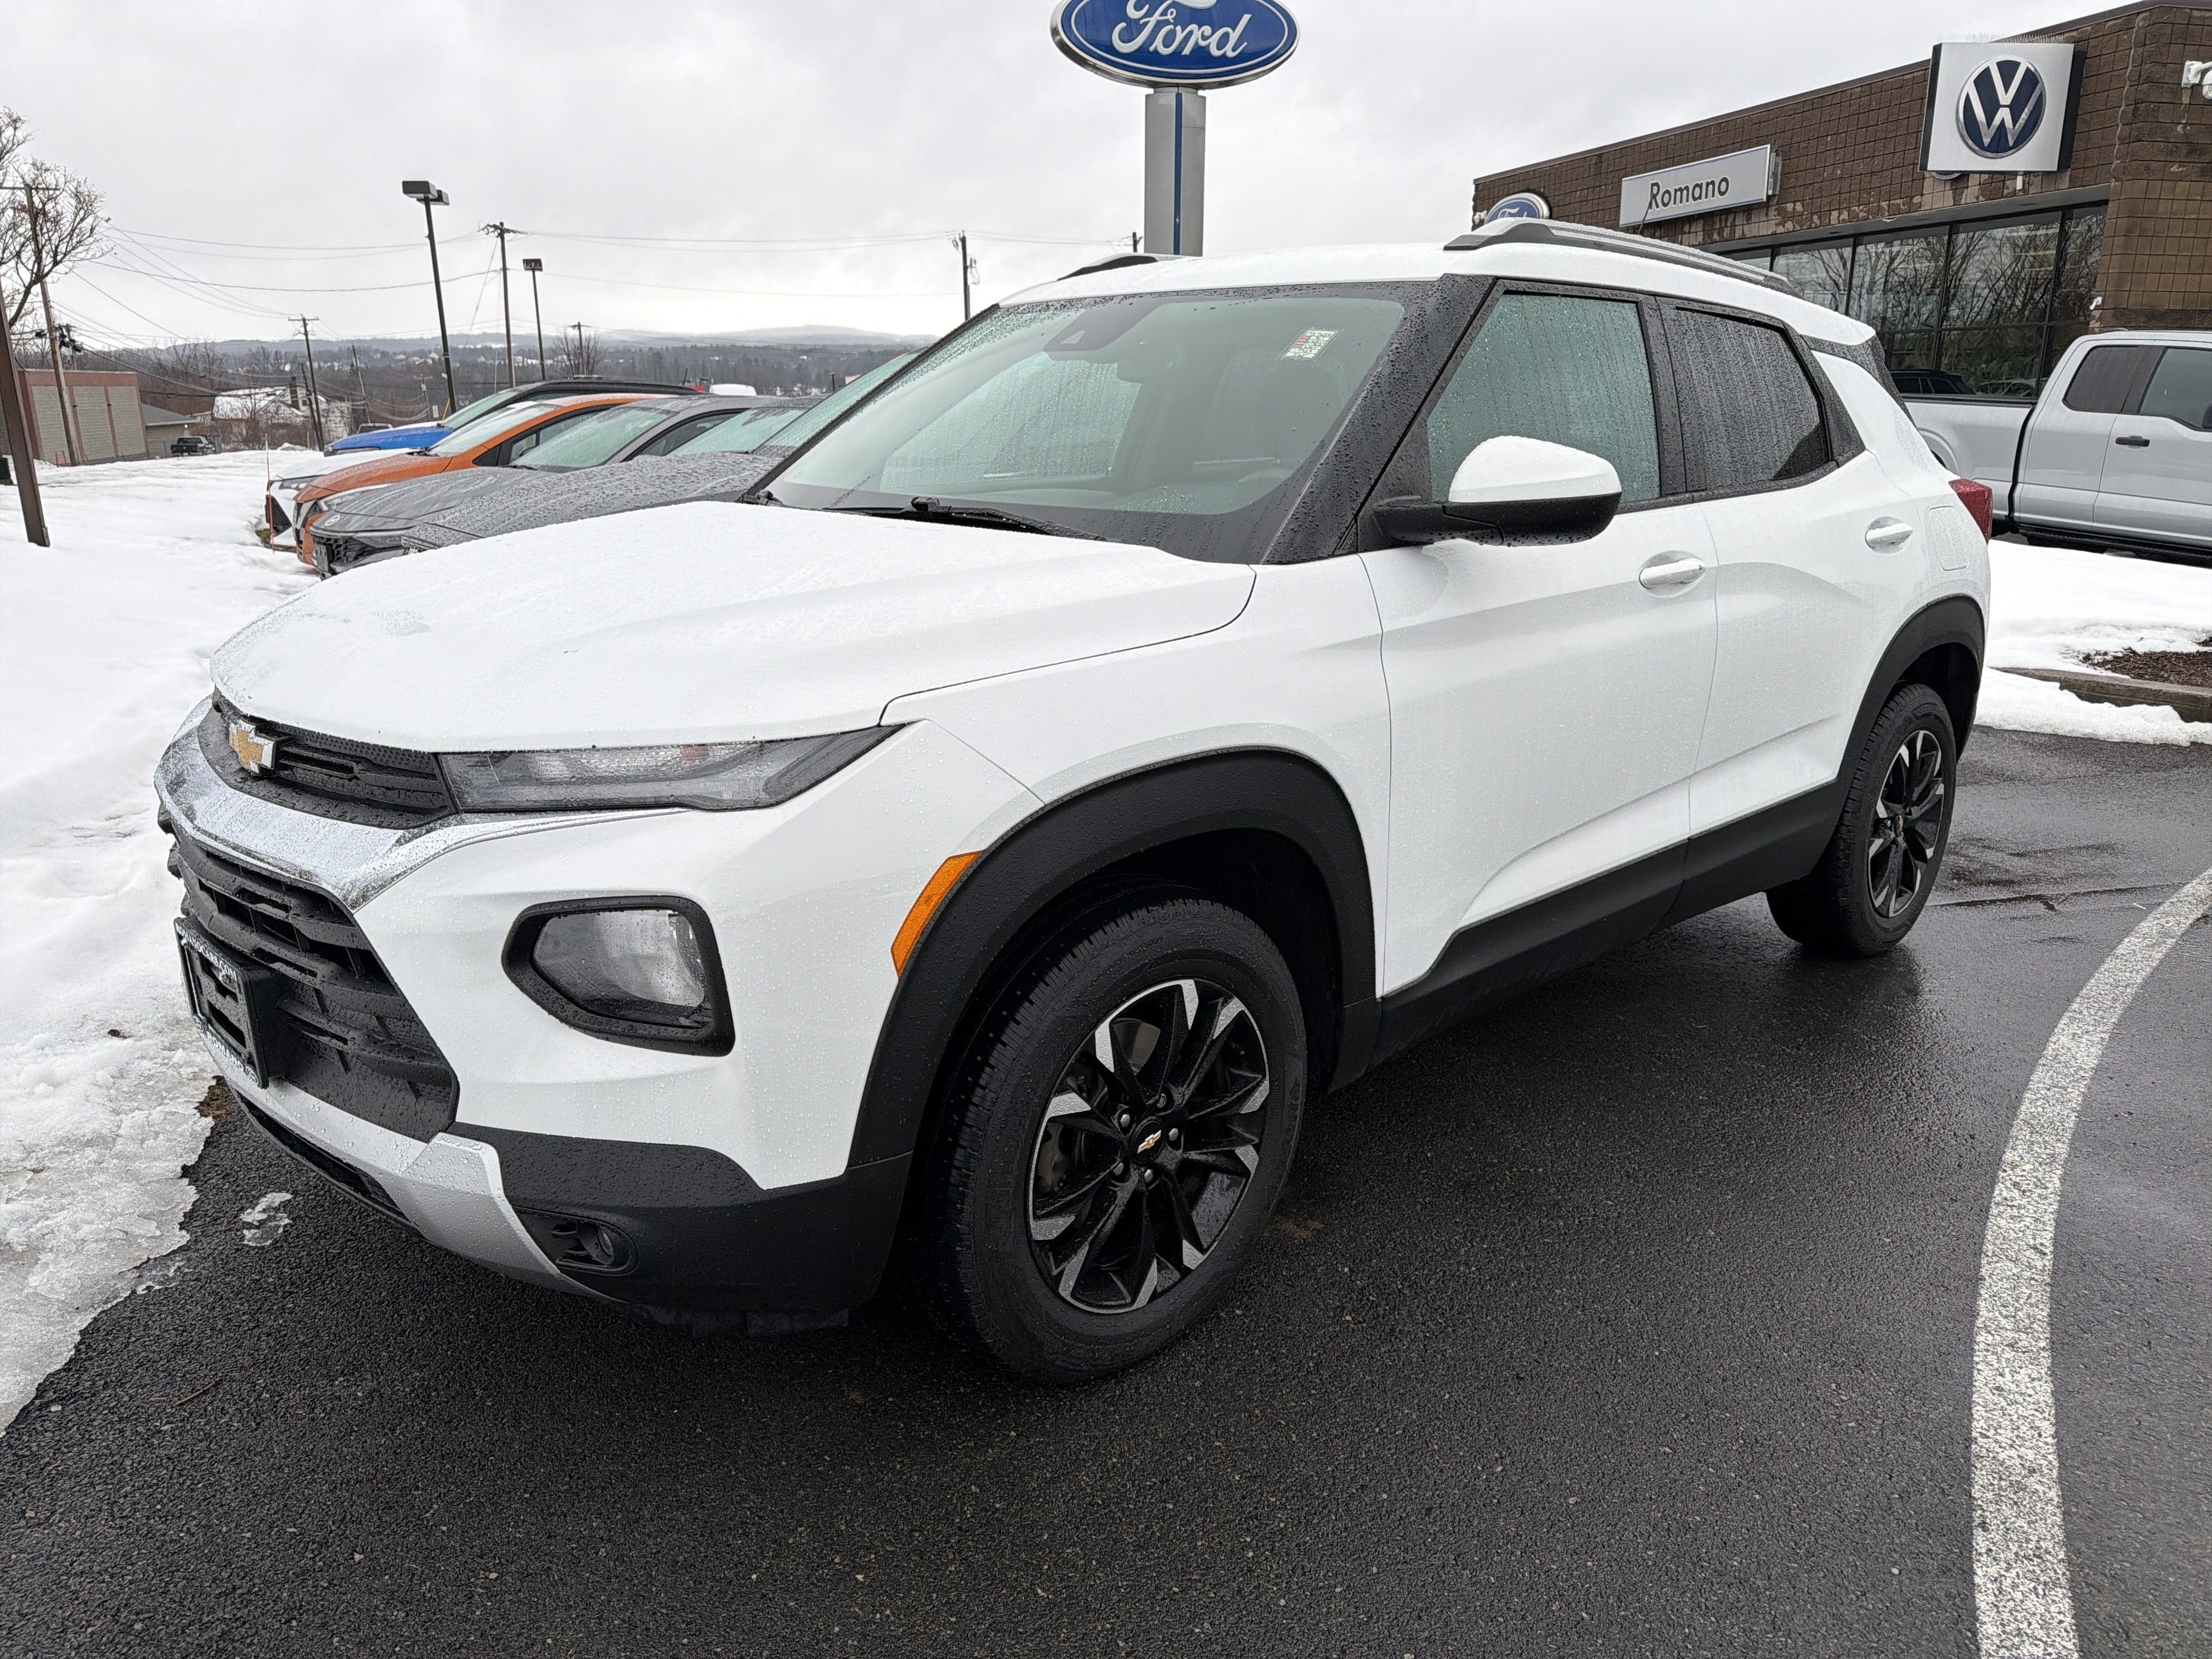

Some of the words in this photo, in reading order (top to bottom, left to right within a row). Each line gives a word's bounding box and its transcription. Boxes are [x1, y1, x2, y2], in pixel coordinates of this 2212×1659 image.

[1112, 0, 1252, 58] Ford
[1649, 177, 1730, 210] Romano
[206, 1031, 245, 1073] ROMANO
